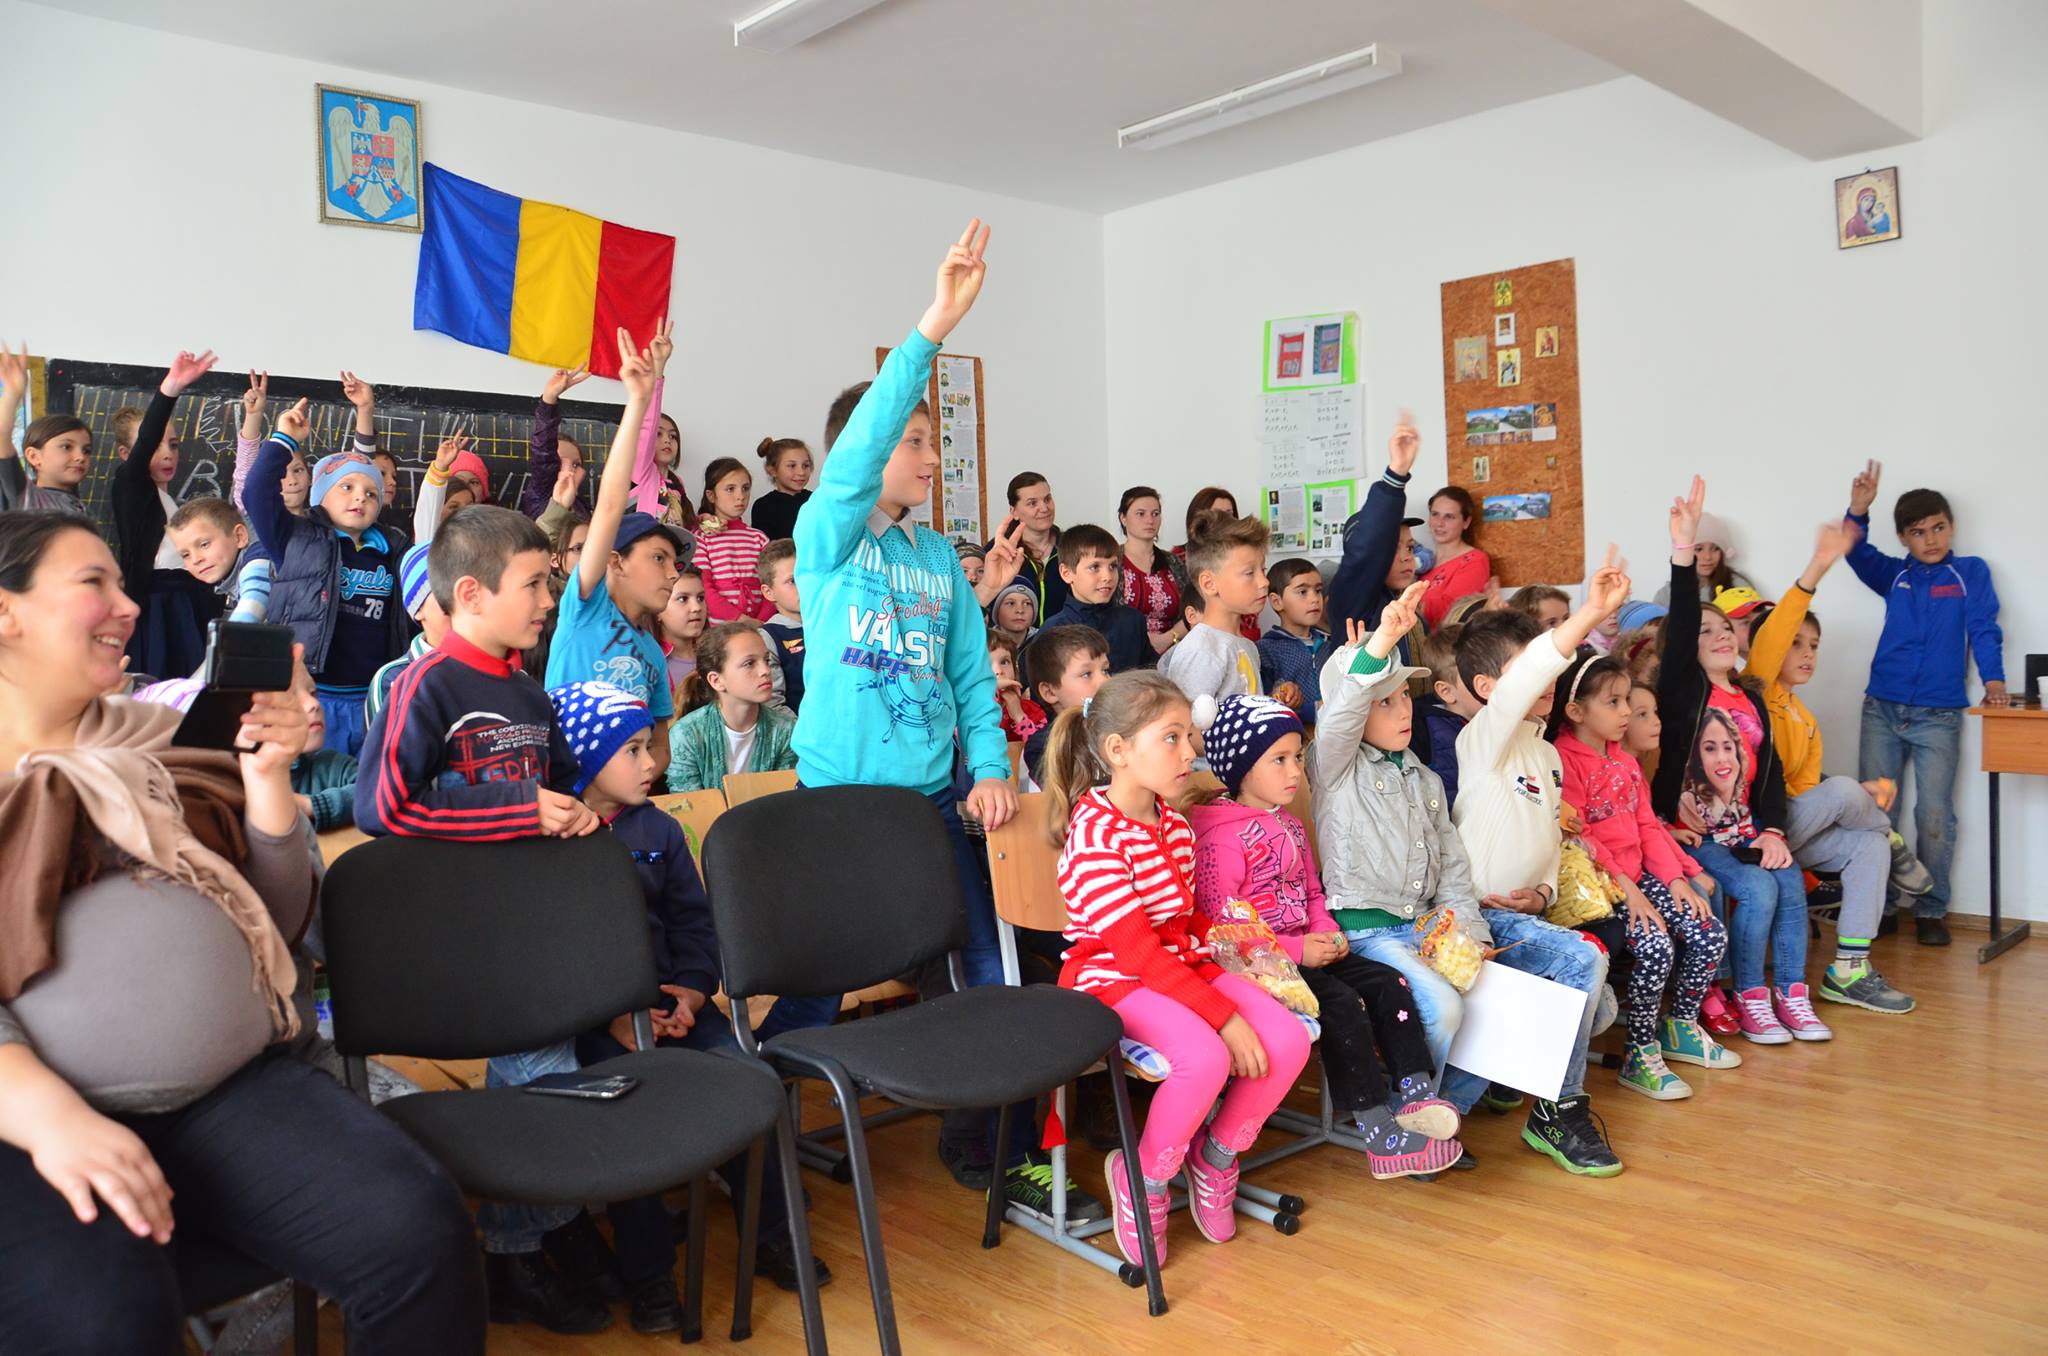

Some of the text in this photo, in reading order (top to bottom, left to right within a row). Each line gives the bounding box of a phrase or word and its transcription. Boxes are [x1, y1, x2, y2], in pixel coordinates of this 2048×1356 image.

[340, 565, 394, 600] oyals
[364, 597, 385, 620] 78
[490, 743, 512, 752] NEW
